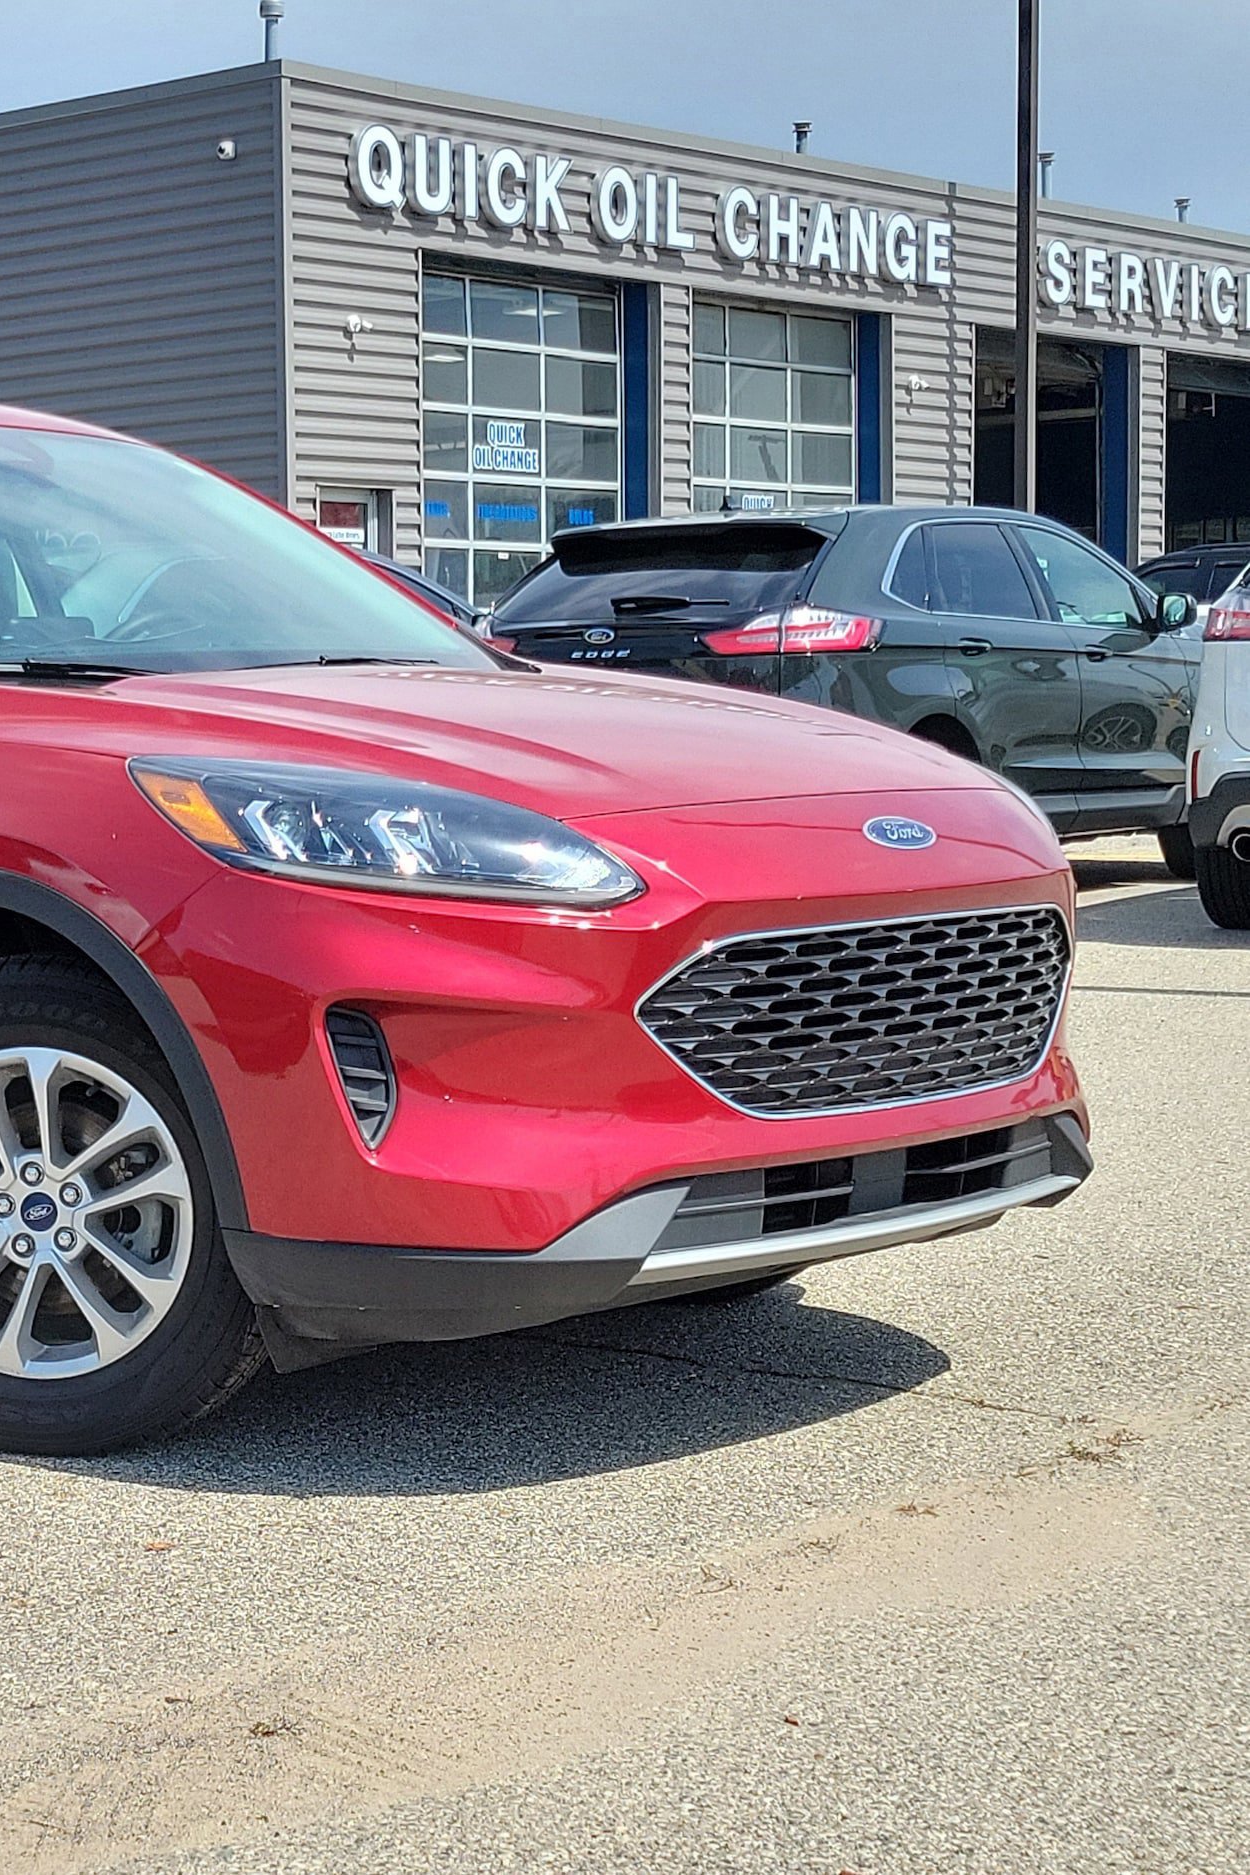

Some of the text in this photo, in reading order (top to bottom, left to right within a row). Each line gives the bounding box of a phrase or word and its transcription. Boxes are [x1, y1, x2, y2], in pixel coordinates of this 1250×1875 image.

[354, 123, 951, 286] QUICK OIL CHANGE
[1040, 239, 1250, 329] SERVIC
[487, 422, 524, 445] QUICK
[474, 447, 538, 471] OIL CHANGE
[570, 649, 630, 659] EDGE
